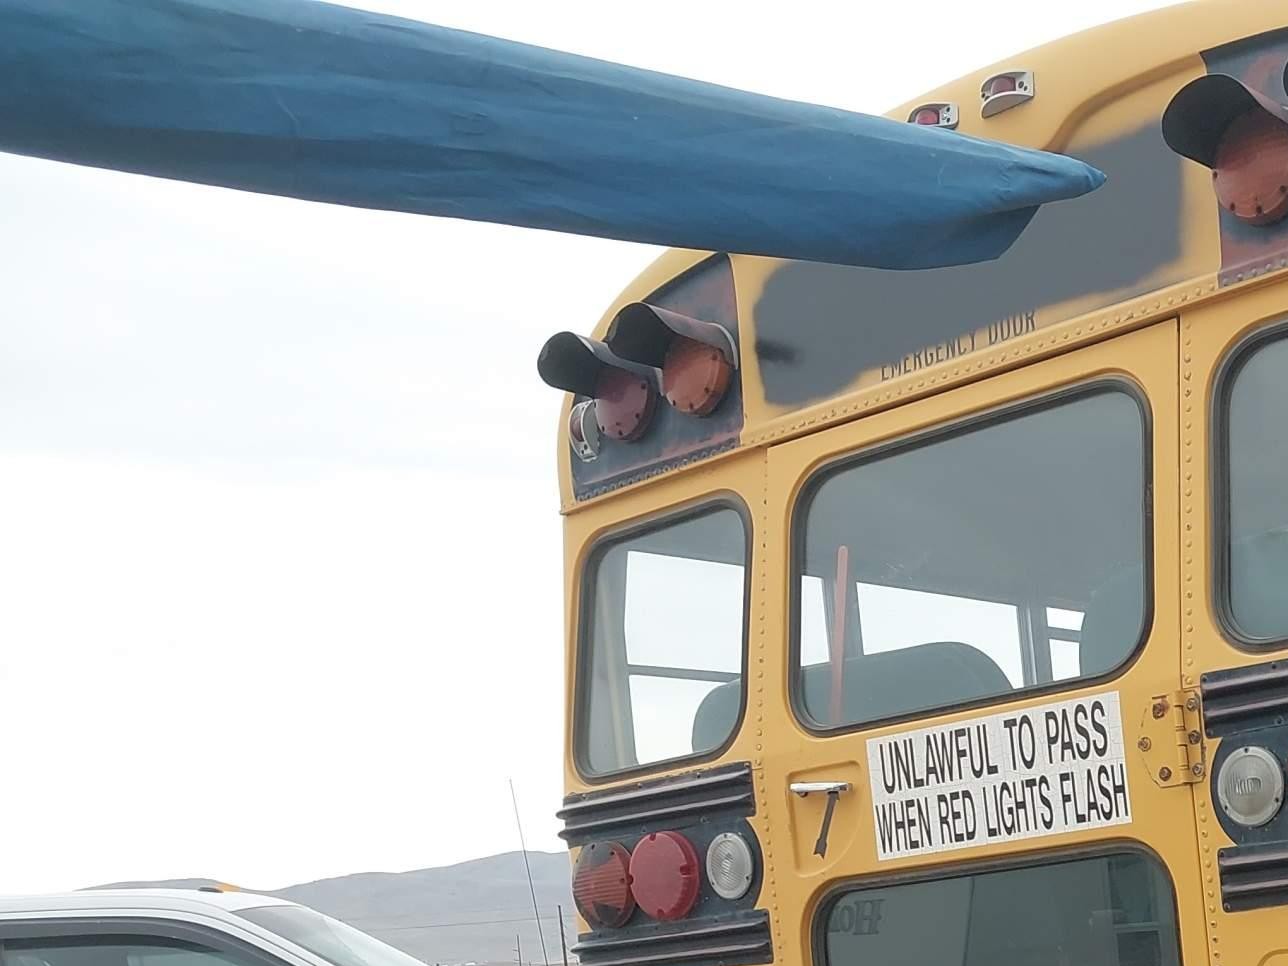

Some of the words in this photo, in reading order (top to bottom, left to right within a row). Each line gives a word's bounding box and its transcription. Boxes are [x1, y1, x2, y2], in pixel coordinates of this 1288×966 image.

[879, 723, 999, 794] UNLAWFUL
[1003, 714, 1036, 770] TO
[1044, 700, 1108, 764] PASS
[875, 796, 933, 854] WHEN
[937, 789, 977, 845] RED
[982, 774, 1054, 836] LIGHTS
[1058, 763, 1129, 826] FLASH
